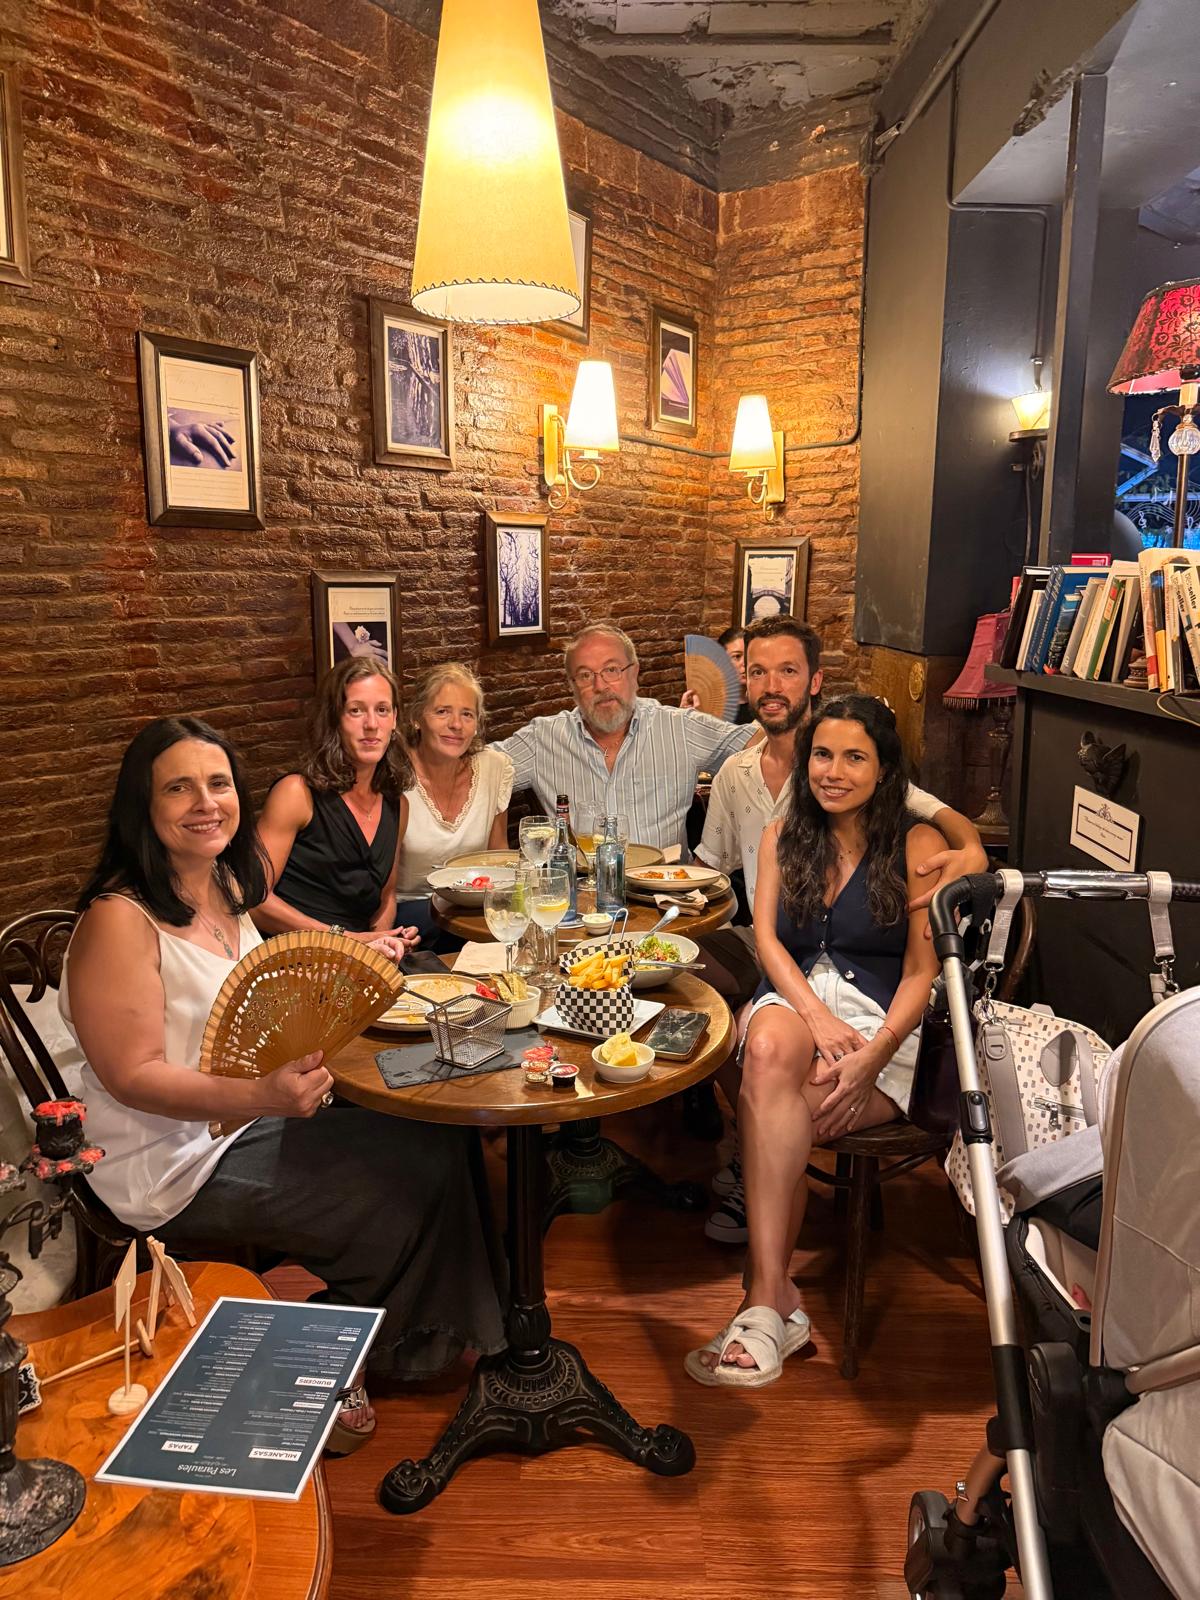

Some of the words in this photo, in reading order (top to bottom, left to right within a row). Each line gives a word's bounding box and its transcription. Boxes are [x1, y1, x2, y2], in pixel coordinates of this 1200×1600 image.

[298, 1378, 332, 1386] BURGERS
[168, 1443, 193, 1451] TAPAS
[253, 1450, 297, 1459] MILANESAS
[178, 1464, 219, 1475] Paraules
[219, 1466, 237, 1477] Les
